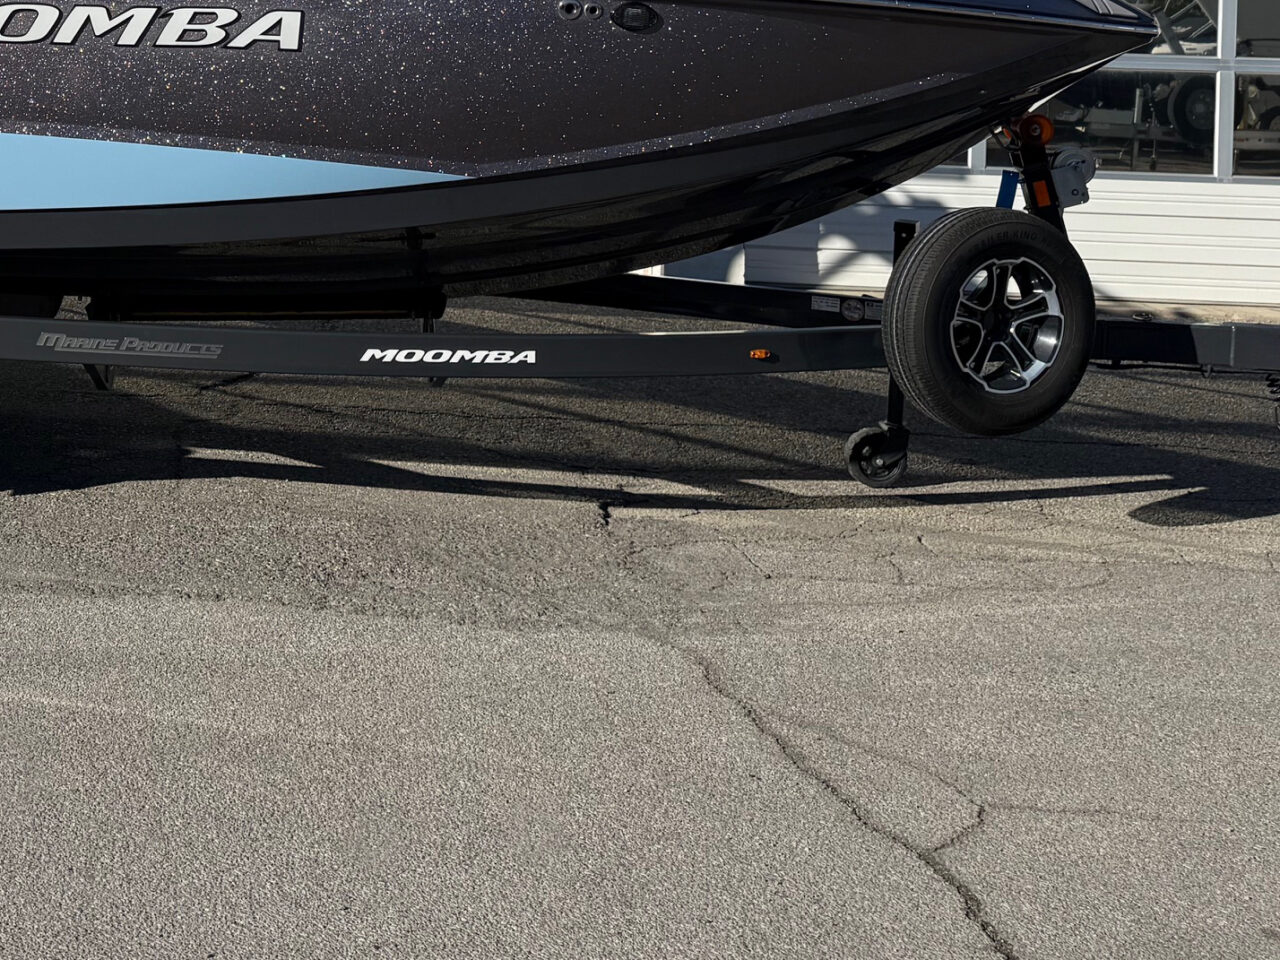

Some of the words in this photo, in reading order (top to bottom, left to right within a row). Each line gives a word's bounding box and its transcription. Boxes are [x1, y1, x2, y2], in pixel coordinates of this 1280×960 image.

[36, 331, 120, 352] MARINE
[119, 336, 225, 358] PRODUCTS
[359, 348, 537, 364] MOOMBA
